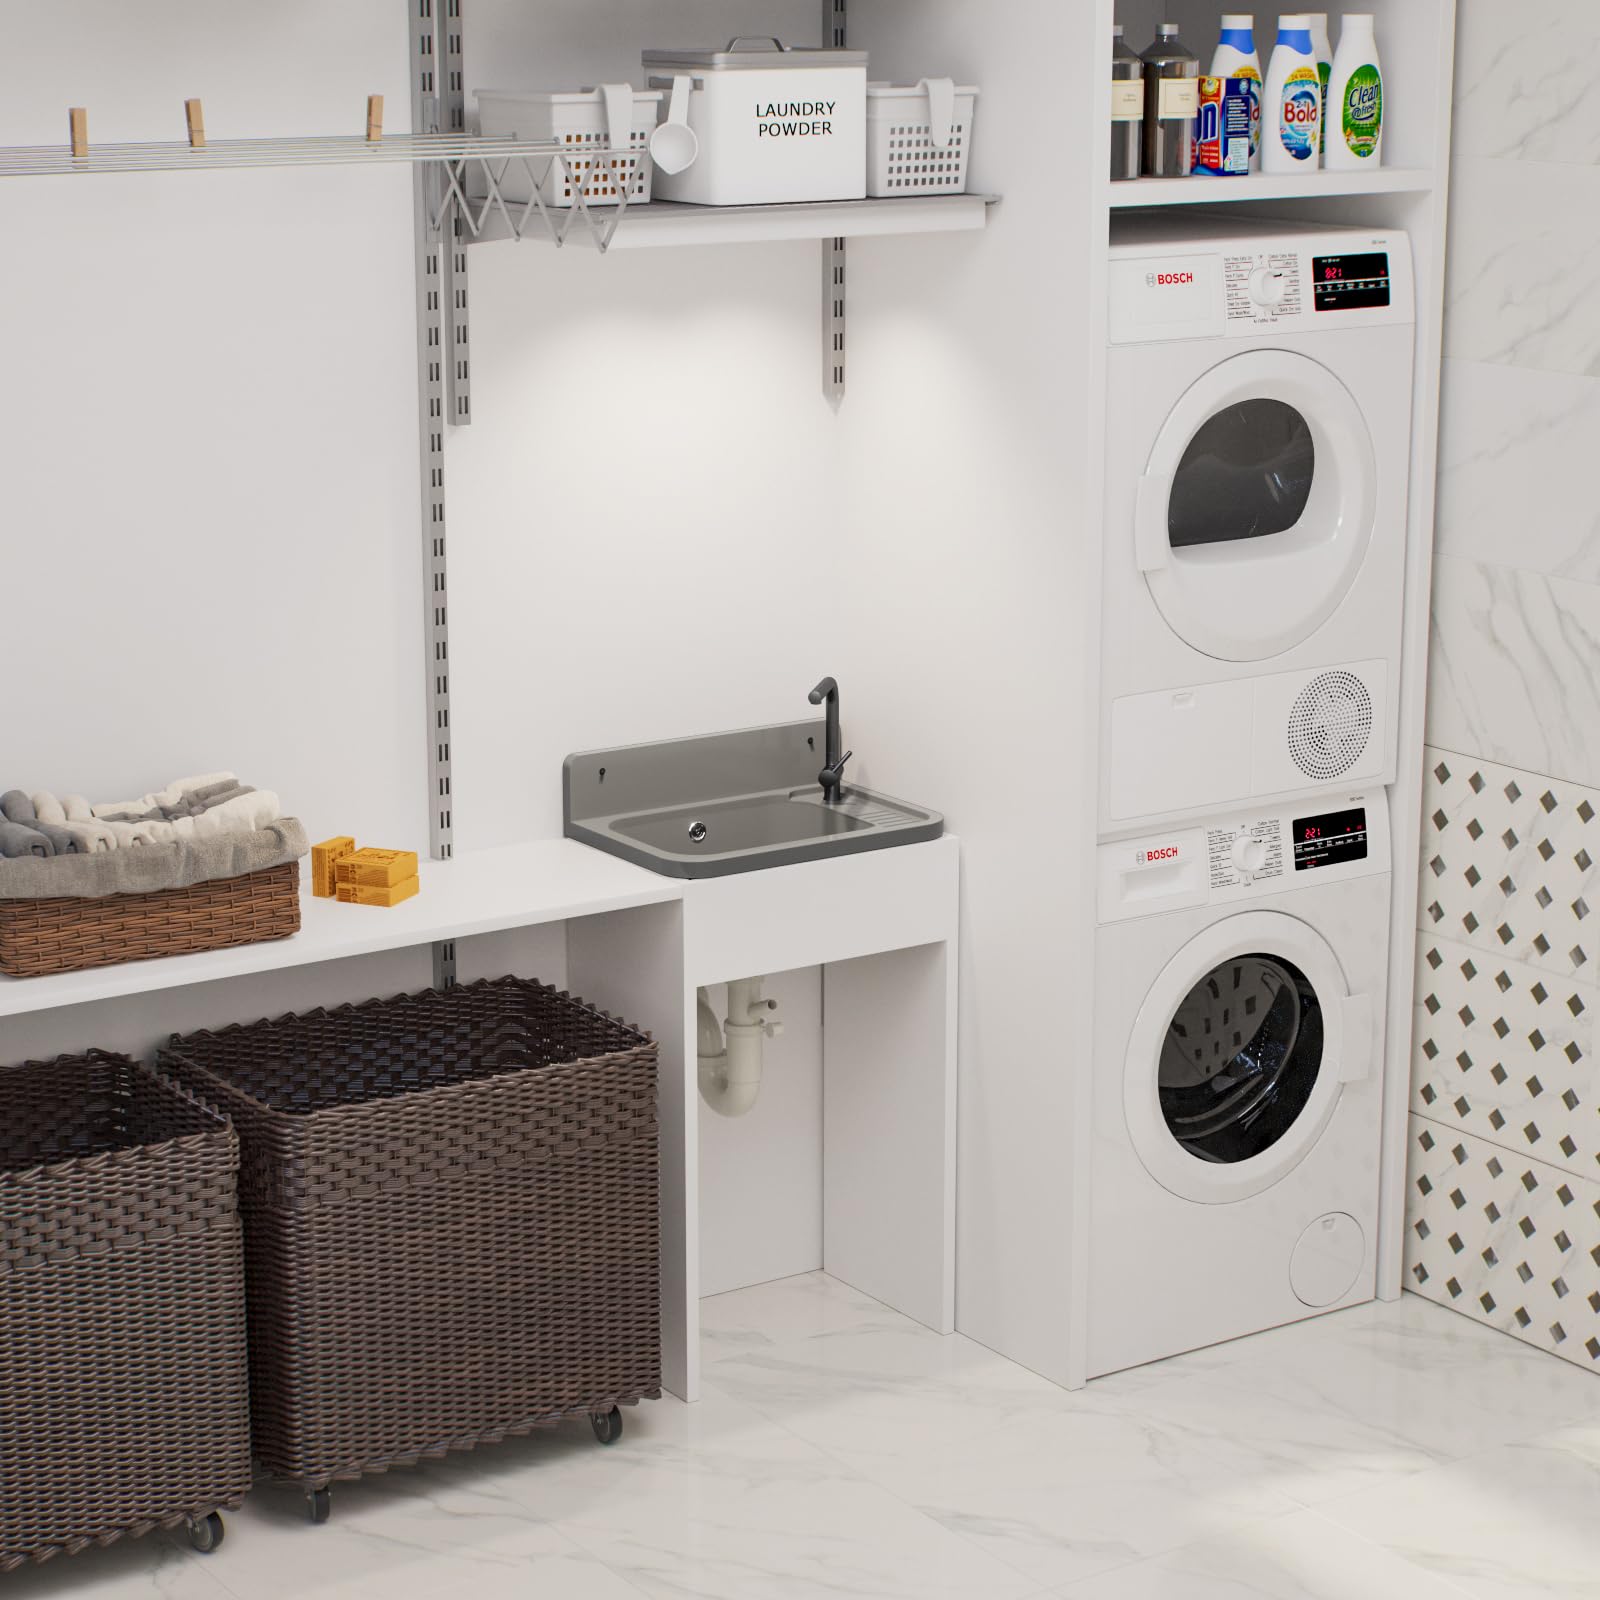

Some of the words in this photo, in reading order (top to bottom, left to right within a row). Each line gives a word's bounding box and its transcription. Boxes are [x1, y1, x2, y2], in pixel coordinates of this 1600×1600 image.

[1349, 84, 1379, 107] Clean
[756, 101, 836, 118] LAUNDRY
[1284, 102, 1317, 123] Bold
[759, 121, 833, 137] POWDER
[1157, 272, 1193, 285] BOSCH
[1147, 846, 1178, 861] BOSCH
